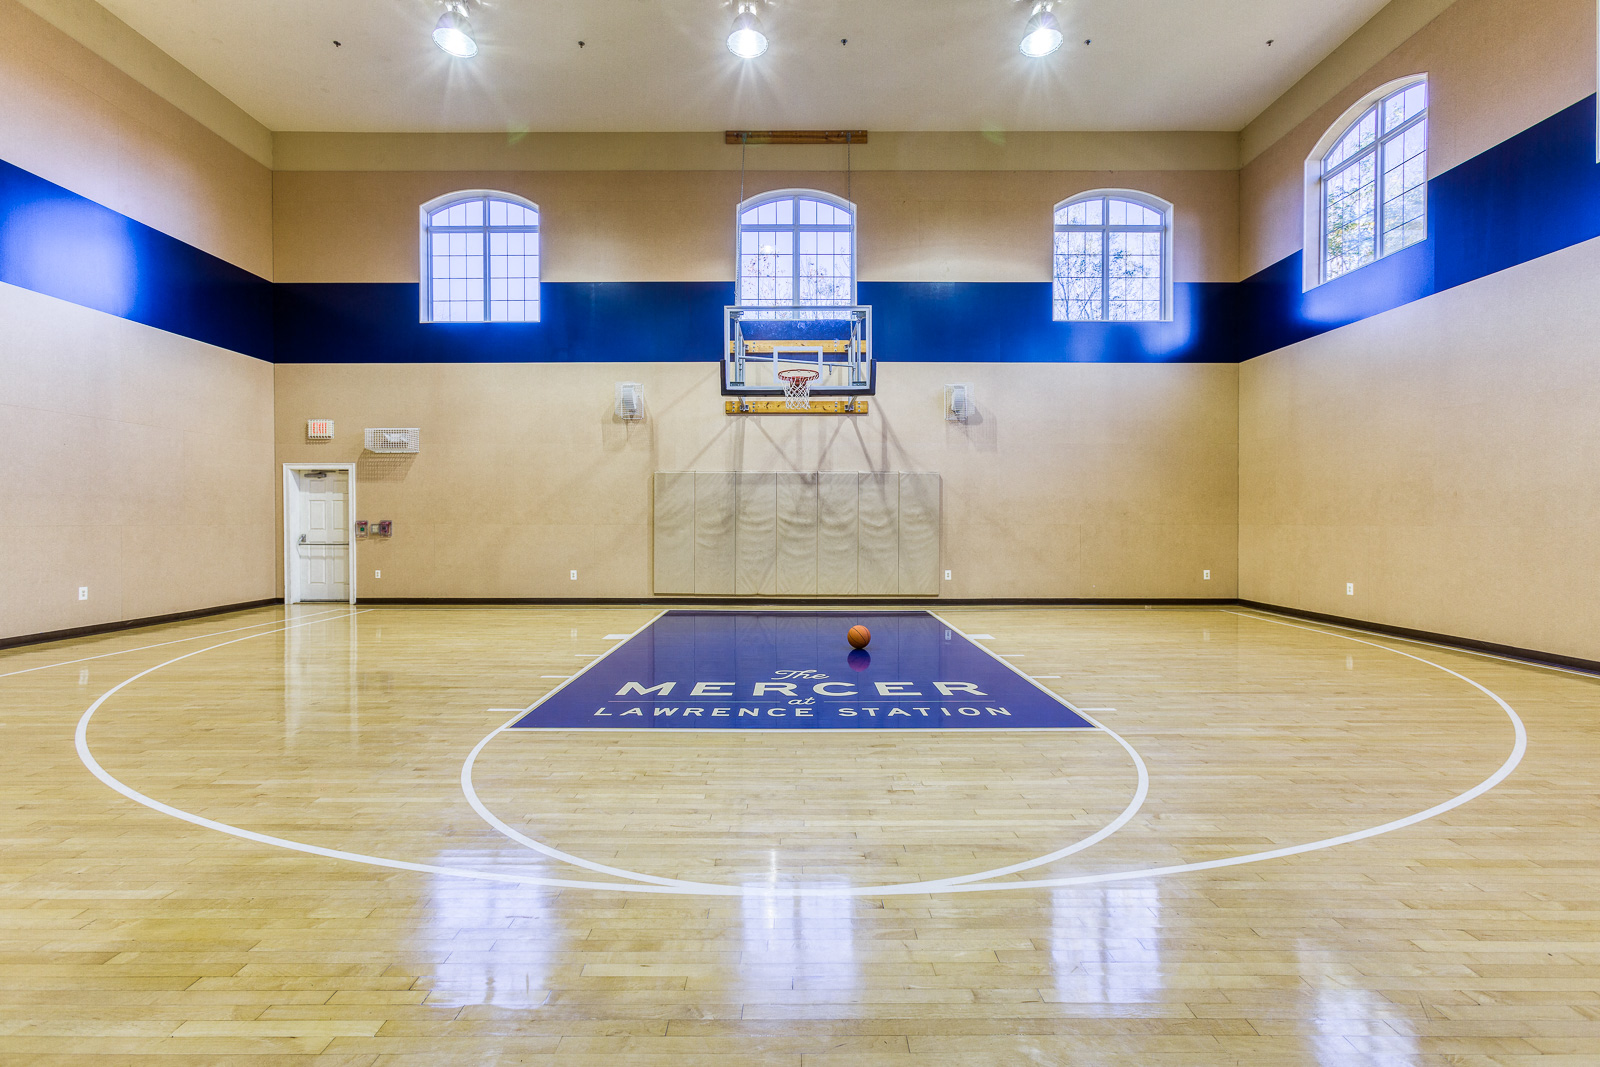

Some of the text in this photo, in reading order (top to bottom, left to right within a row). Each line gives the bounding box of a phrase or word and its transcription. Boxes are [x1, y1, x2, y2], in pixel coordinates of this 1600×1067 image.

[771, 669, 830, 680] The
[615, 681, 988, 696] MERCER
[787, 696, 816, 705] at
[593, 707, 1012, 717] LAWRENCE STATION
